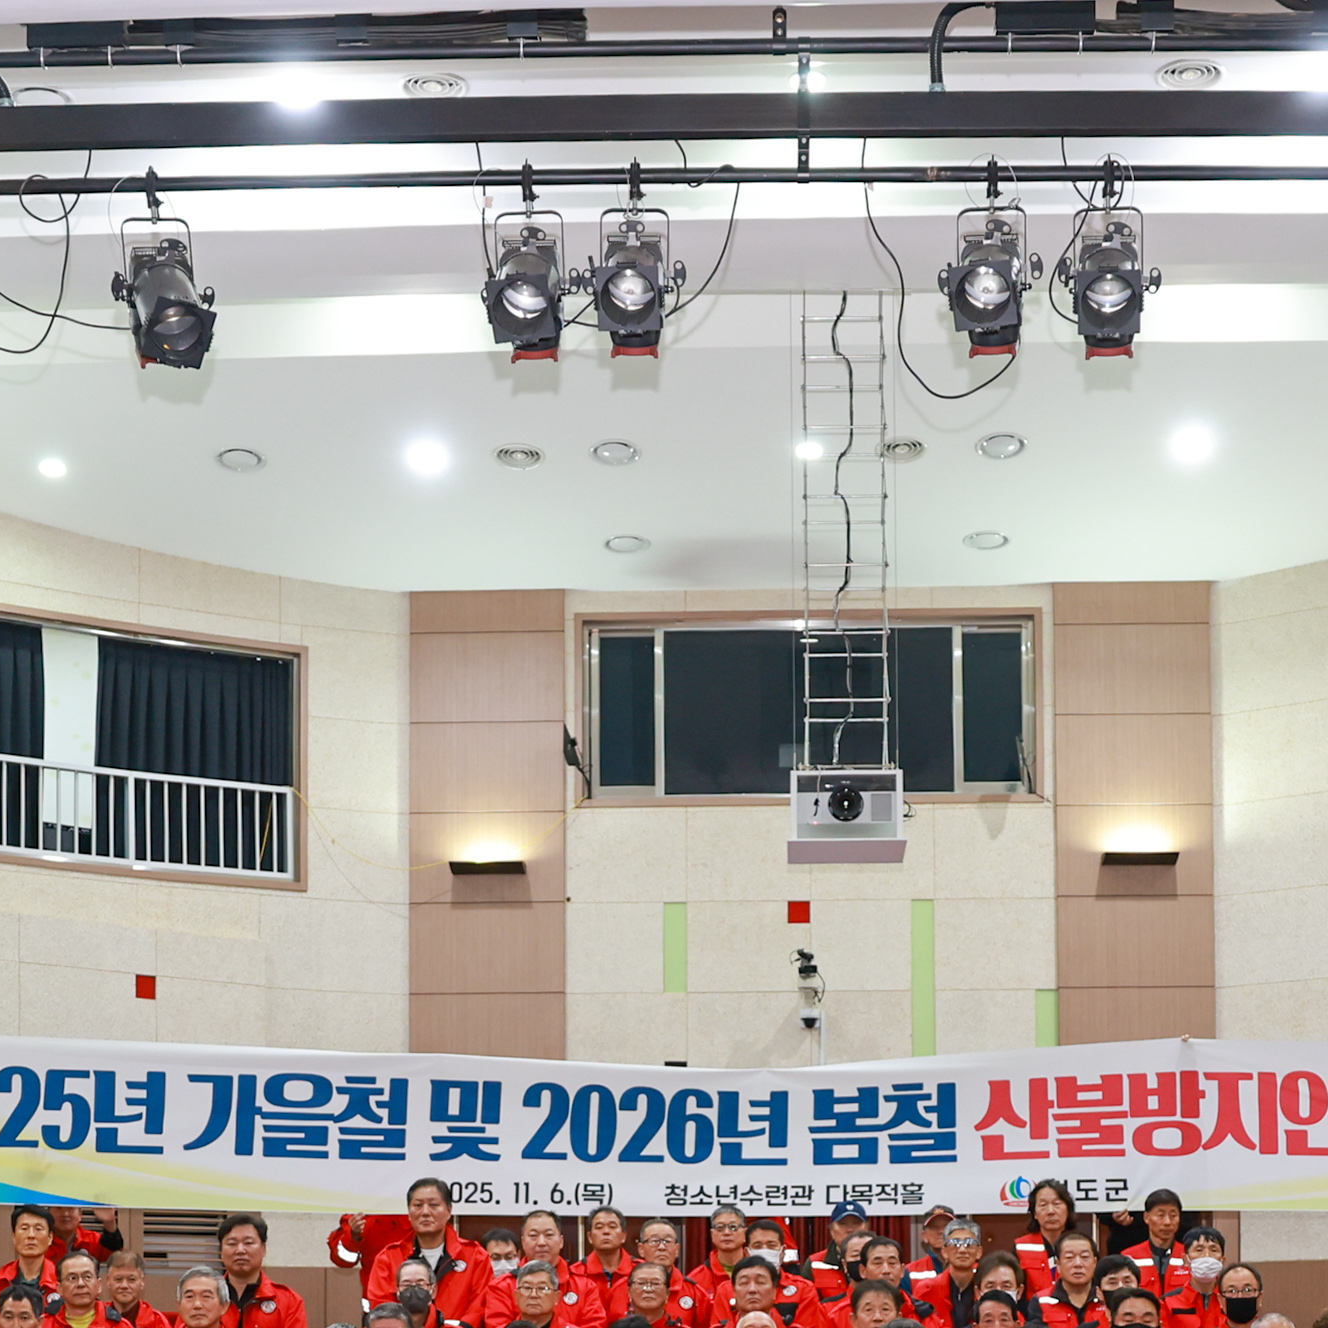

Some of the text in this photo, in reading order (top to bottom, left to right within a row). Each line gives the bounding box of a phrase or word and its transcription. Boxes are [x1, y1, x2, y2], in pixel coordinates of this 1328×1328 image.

[183, 1073, 409, 1161] 가을철
[429, 1079, 502, 1162] 및
[521, 1081, 789, 1166] 2026년
[808, 1081, 958, 1166] 봄철
[448, 1181, 501, 1205] 025.
[513, 1182, 538, 1206] 11.
[663, 1183, 815, 1207] 청소년수련관
[825, 1182, 924, 1206] 다목적홀
[1060, 1178, 1129, 1202] 도군
